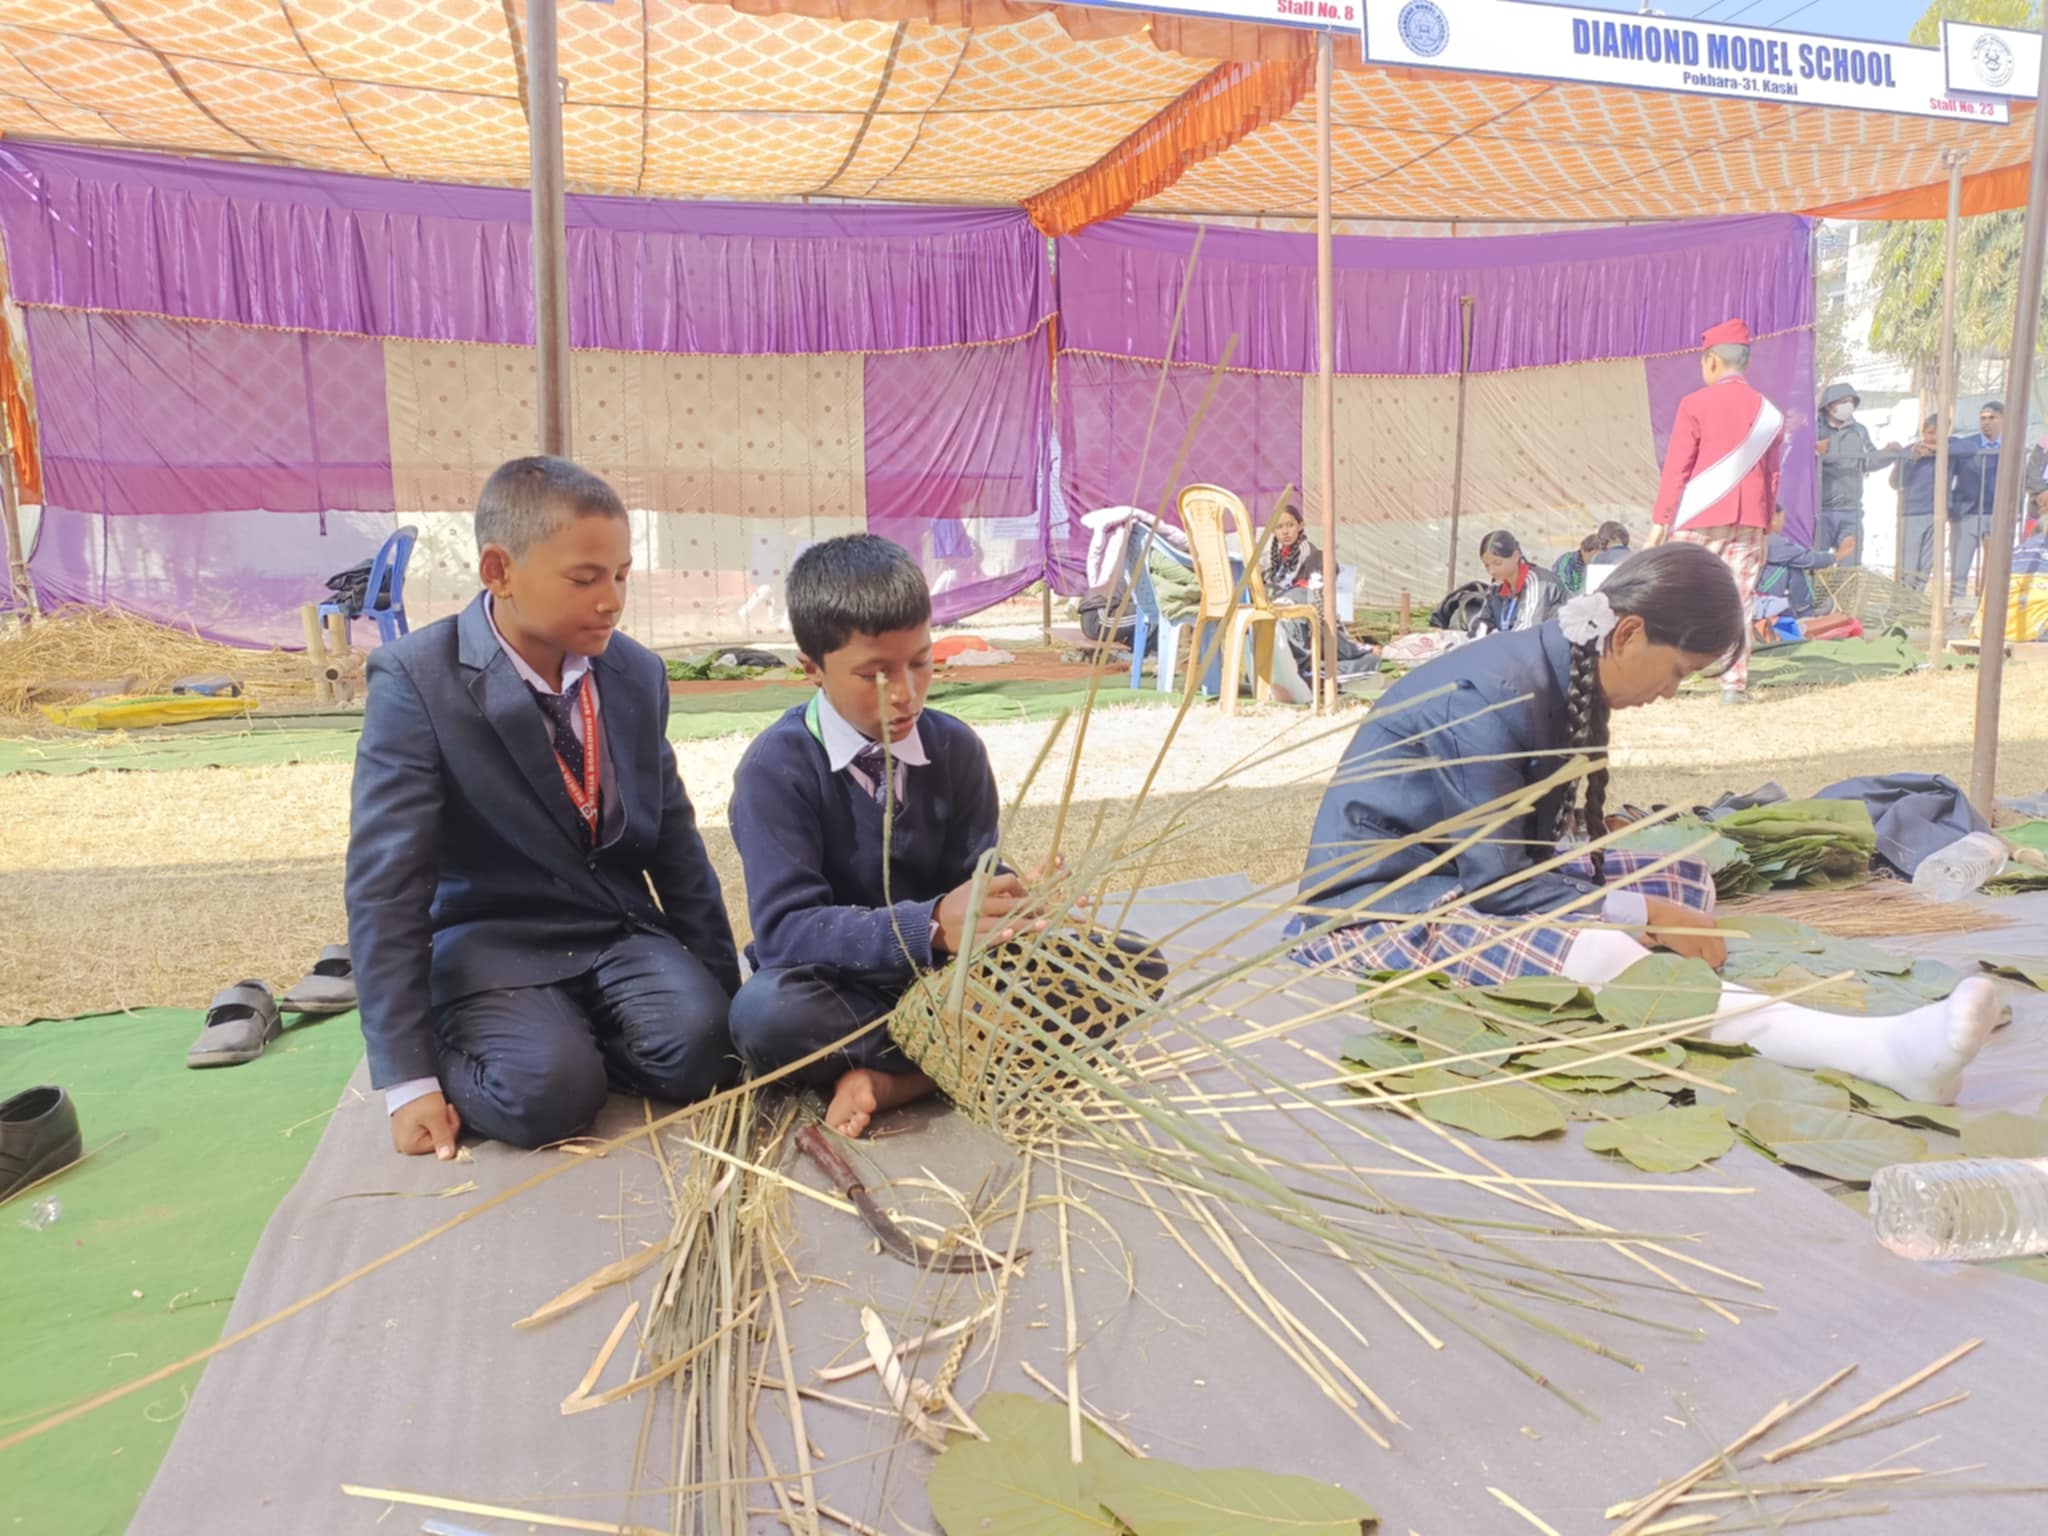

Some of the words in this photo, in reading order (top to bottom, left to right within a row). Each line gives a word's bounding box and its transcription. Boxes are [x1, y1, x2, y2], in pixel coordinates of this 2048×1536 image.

[1277, 0, 1314, 16] Stall
[1318, 2, 1341, 19] No.
[1344, 5, 1354, 20] 8
[1572, 18, 1699, 66] DIAMOND
[1707, 33, 1793, 76] MODEL
[1798, 43, 1896, 88] SCHOOL
[1762, 79, 1798, 96] Kaski
[1929, 97, 1957, 112] Stall
[1979, 102, 1995, 116] 23
[585, 717, 596, 772] BOARDING
